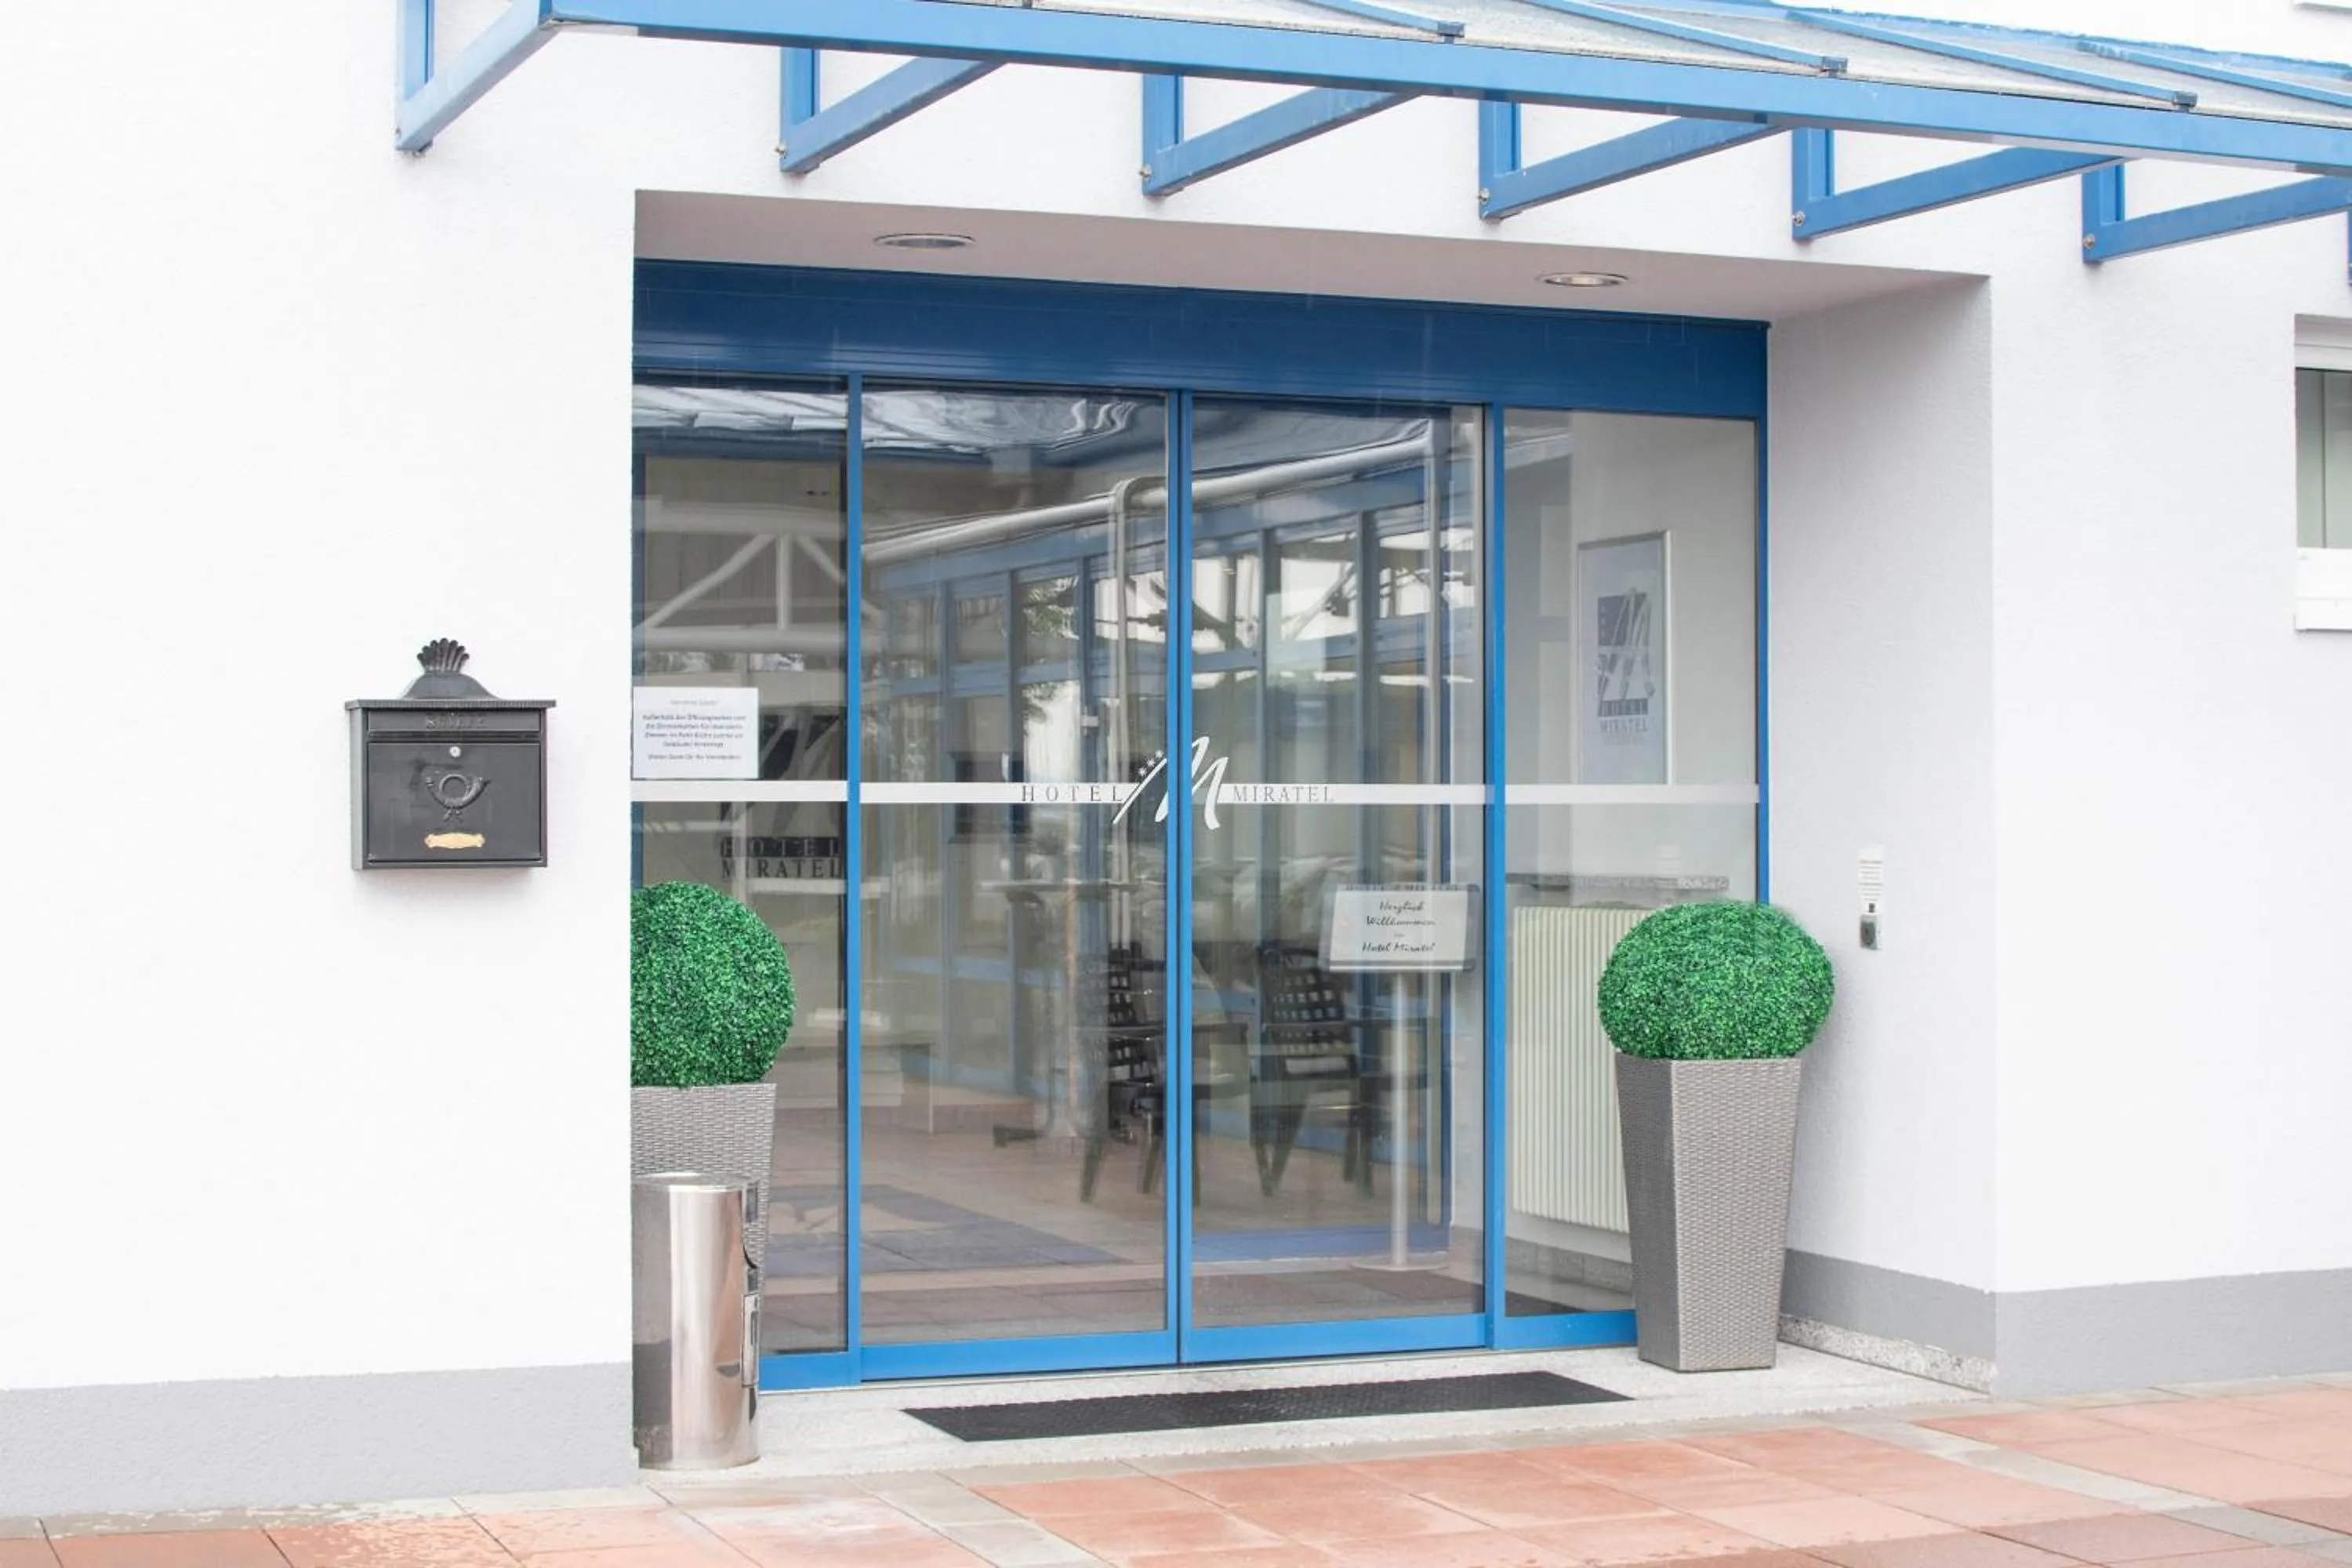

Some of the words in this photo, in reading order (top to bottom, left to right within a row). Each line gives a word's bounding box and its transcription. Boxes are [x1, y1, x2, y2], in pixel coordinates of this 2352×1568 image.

[1021, 786, 1122, 802] HOTEL
[1233, 786, 1334, 803] MIRATEL
[1366, 915, 1436, 926] Willkommen
[1362, 942, 1392, 953] Hotel
